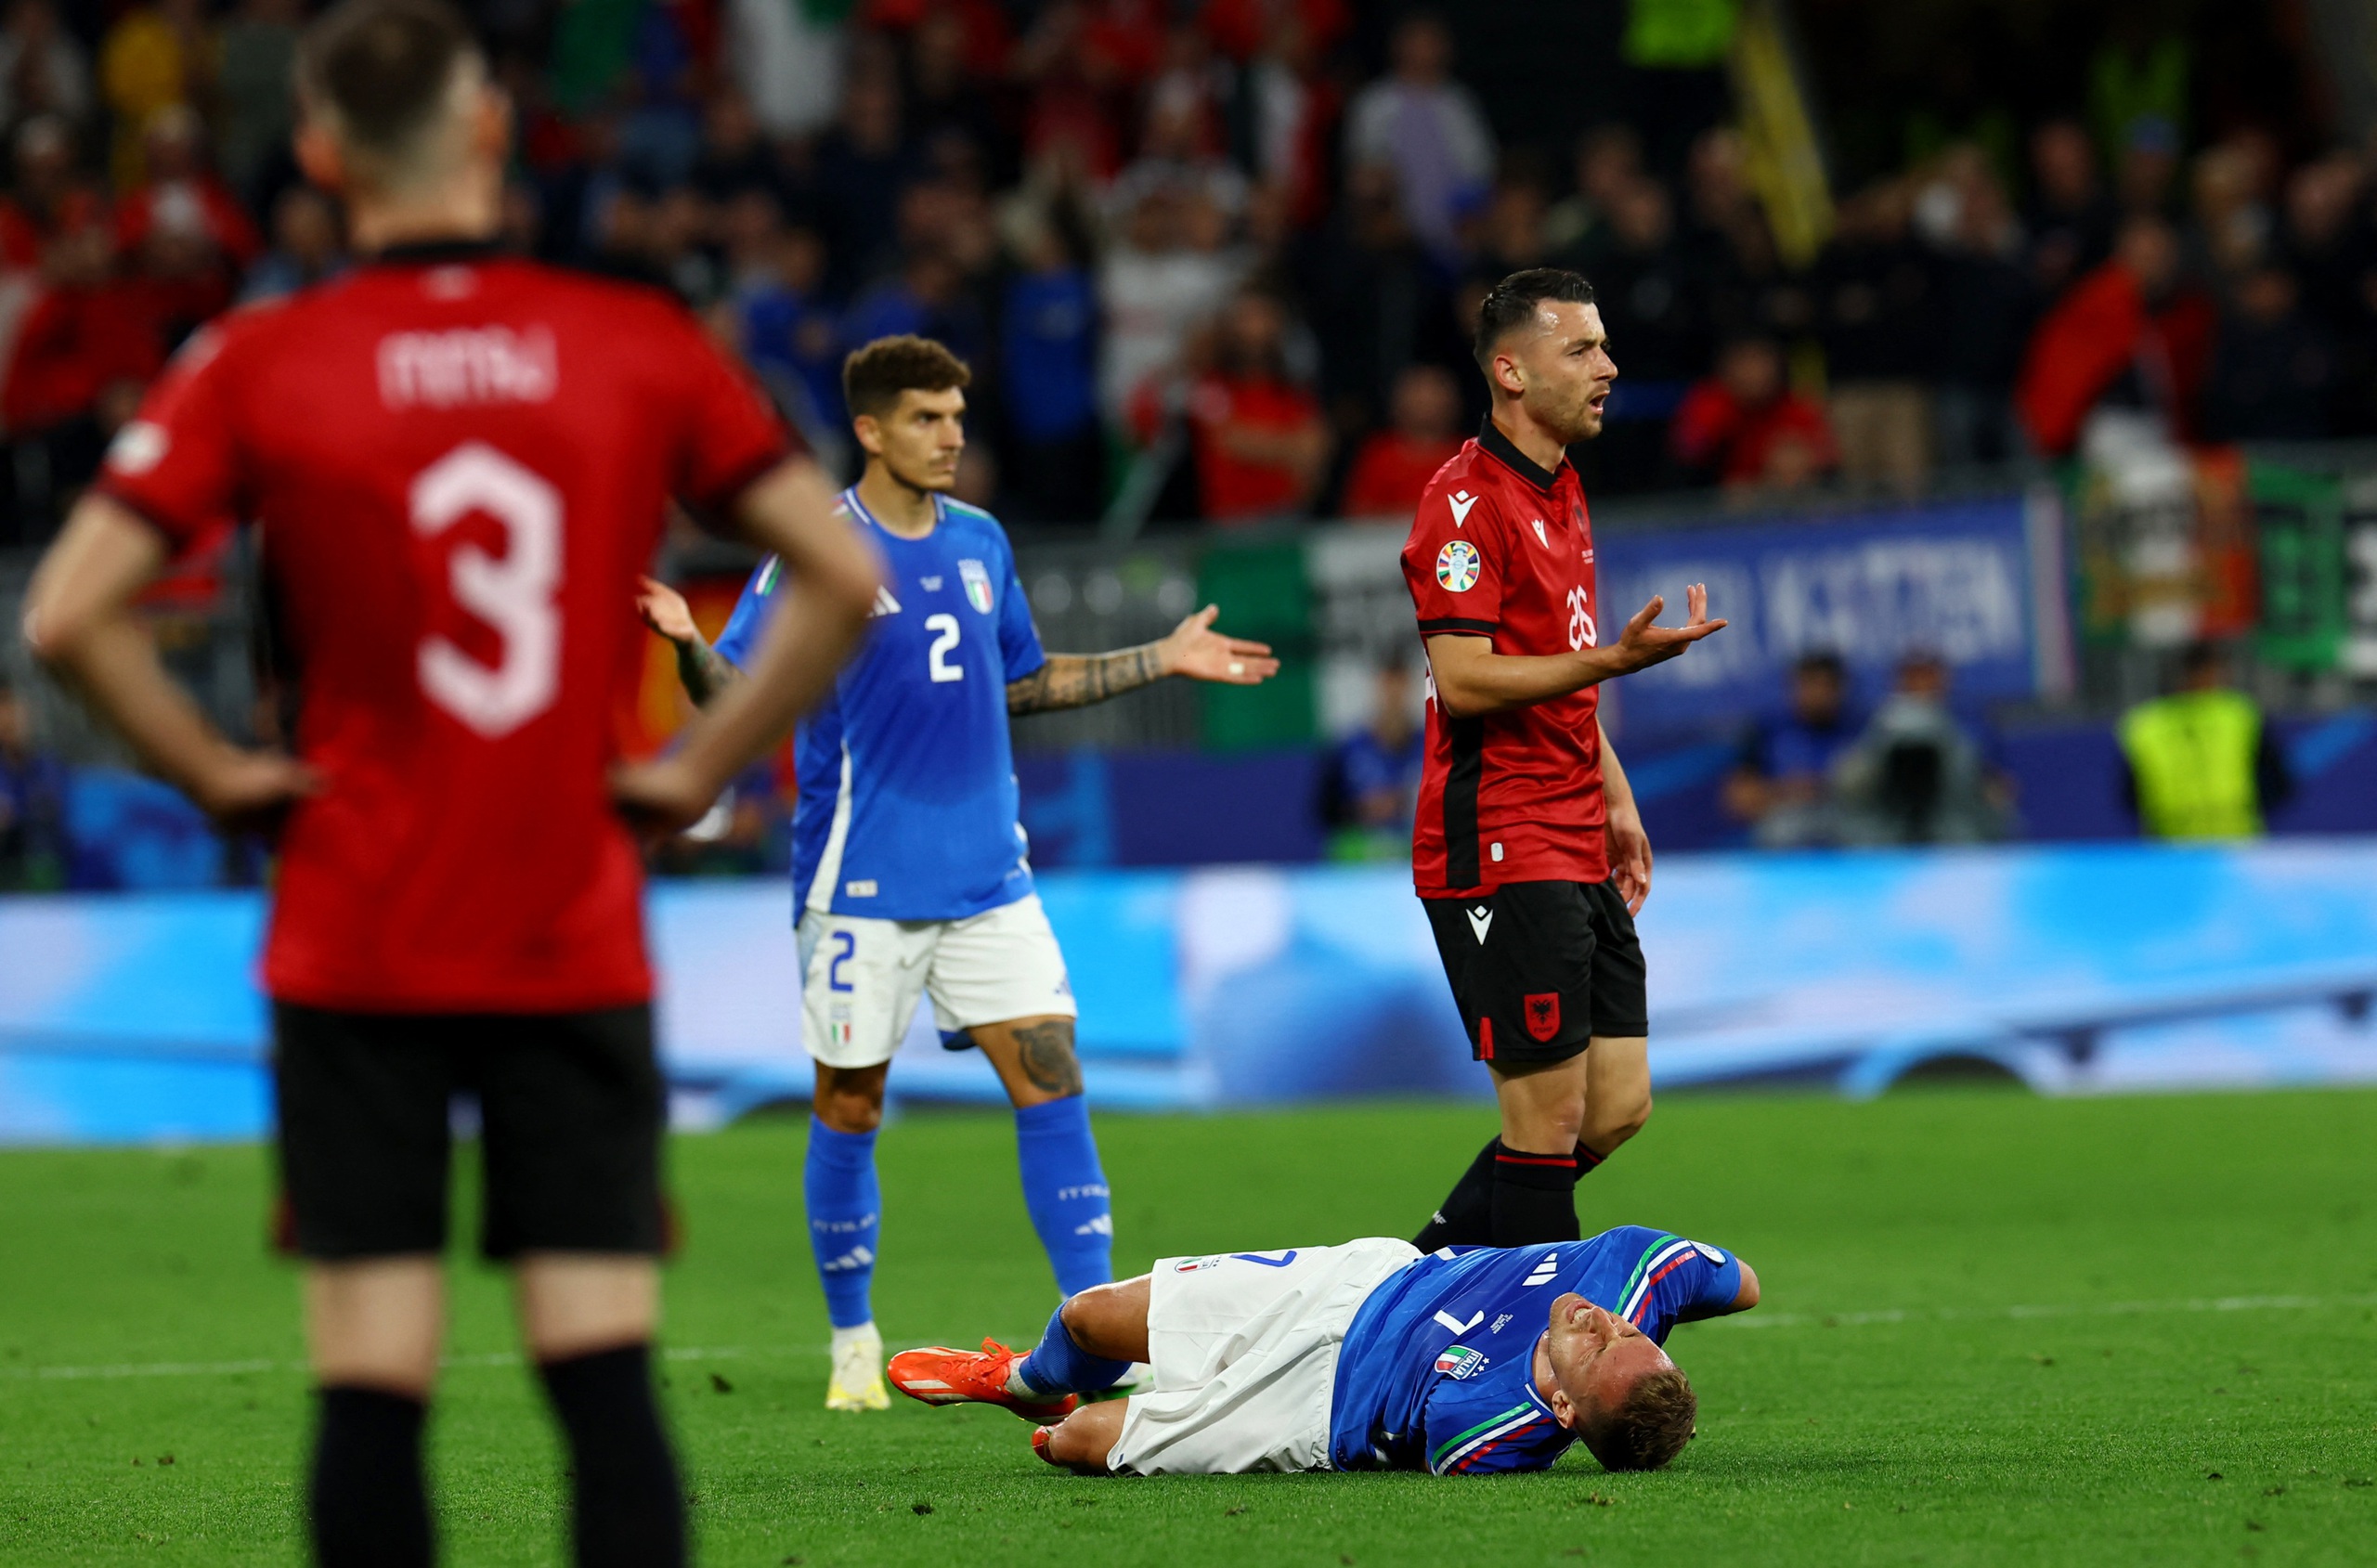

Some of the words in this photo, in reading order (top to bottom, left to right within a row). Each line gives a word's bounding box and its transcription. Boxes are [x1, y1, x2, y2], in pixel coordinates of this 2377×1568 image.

[410, 442, 563, 737] 3
[1566, 584, 1597, 652] 26
[925, 613, 964, 682] 2
[830, 931, 855, 992] 2
[1229, 1250, 1298, 1268] 7
[1433, 1309, 1485, 1336] 7
[1452, 1352, 1481, 1376] ITALIA
